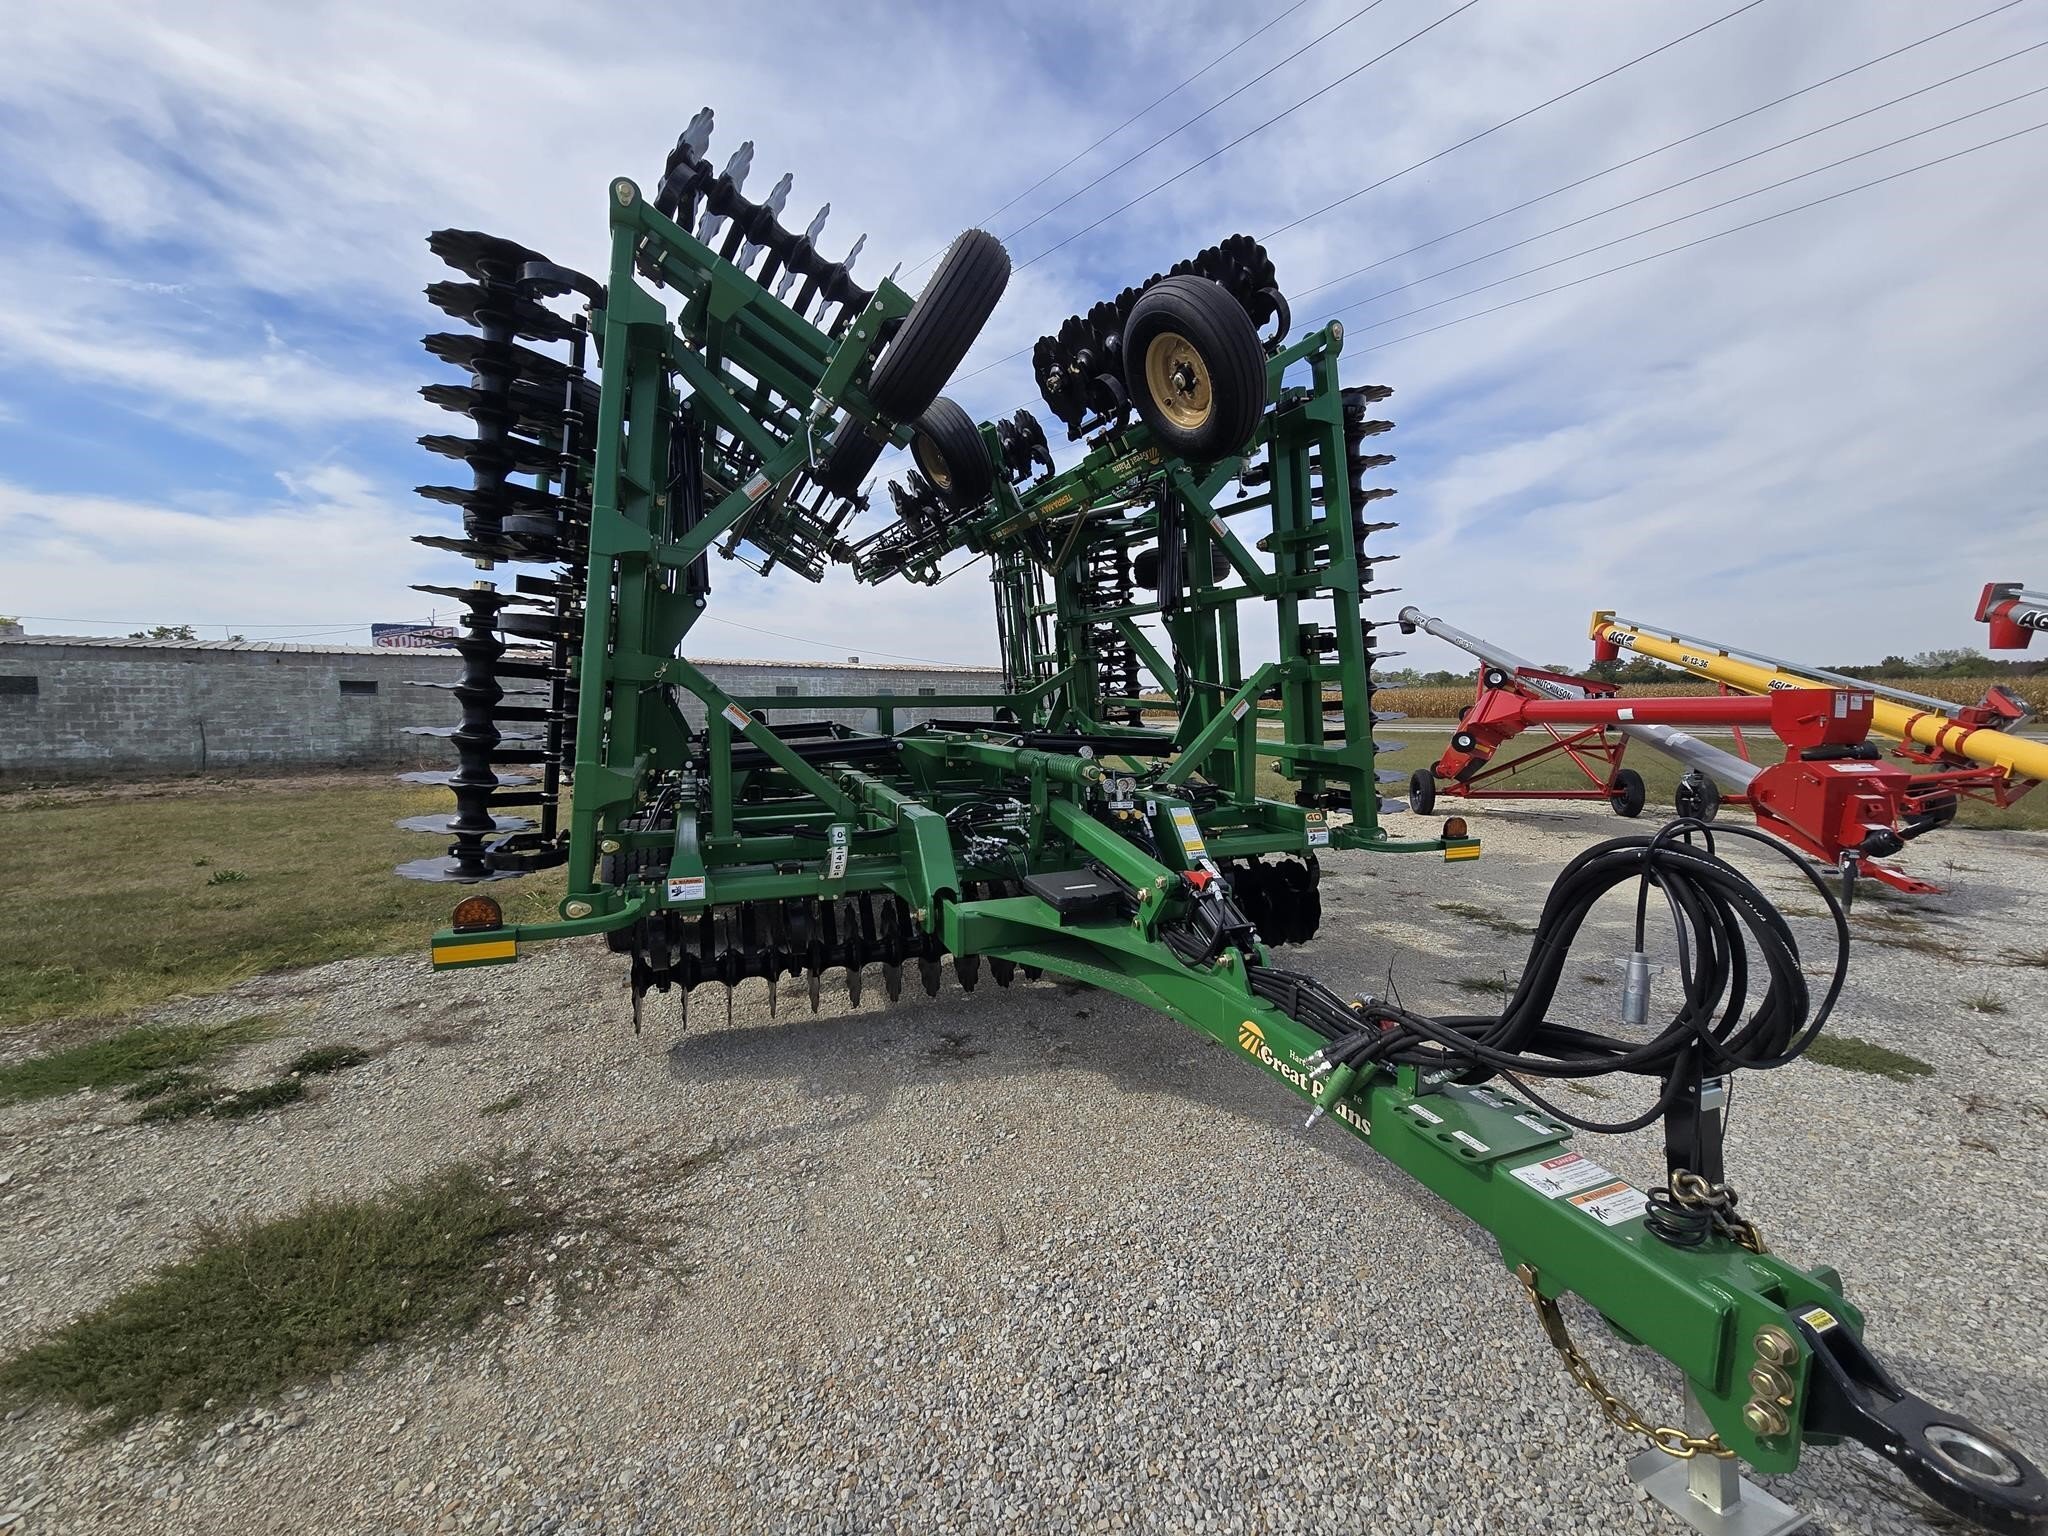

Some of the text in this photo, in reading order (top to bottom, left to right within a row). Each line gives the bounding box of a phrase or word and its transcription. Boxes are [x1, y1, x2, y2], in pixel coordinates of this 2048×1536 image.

[1608, 631, 1628, 646] AGI
[1690, 657, 1709, 668] 13-36
[1768, 679, 1785, 689] AGI
[1260, 1044, 1308, 1091] Great
